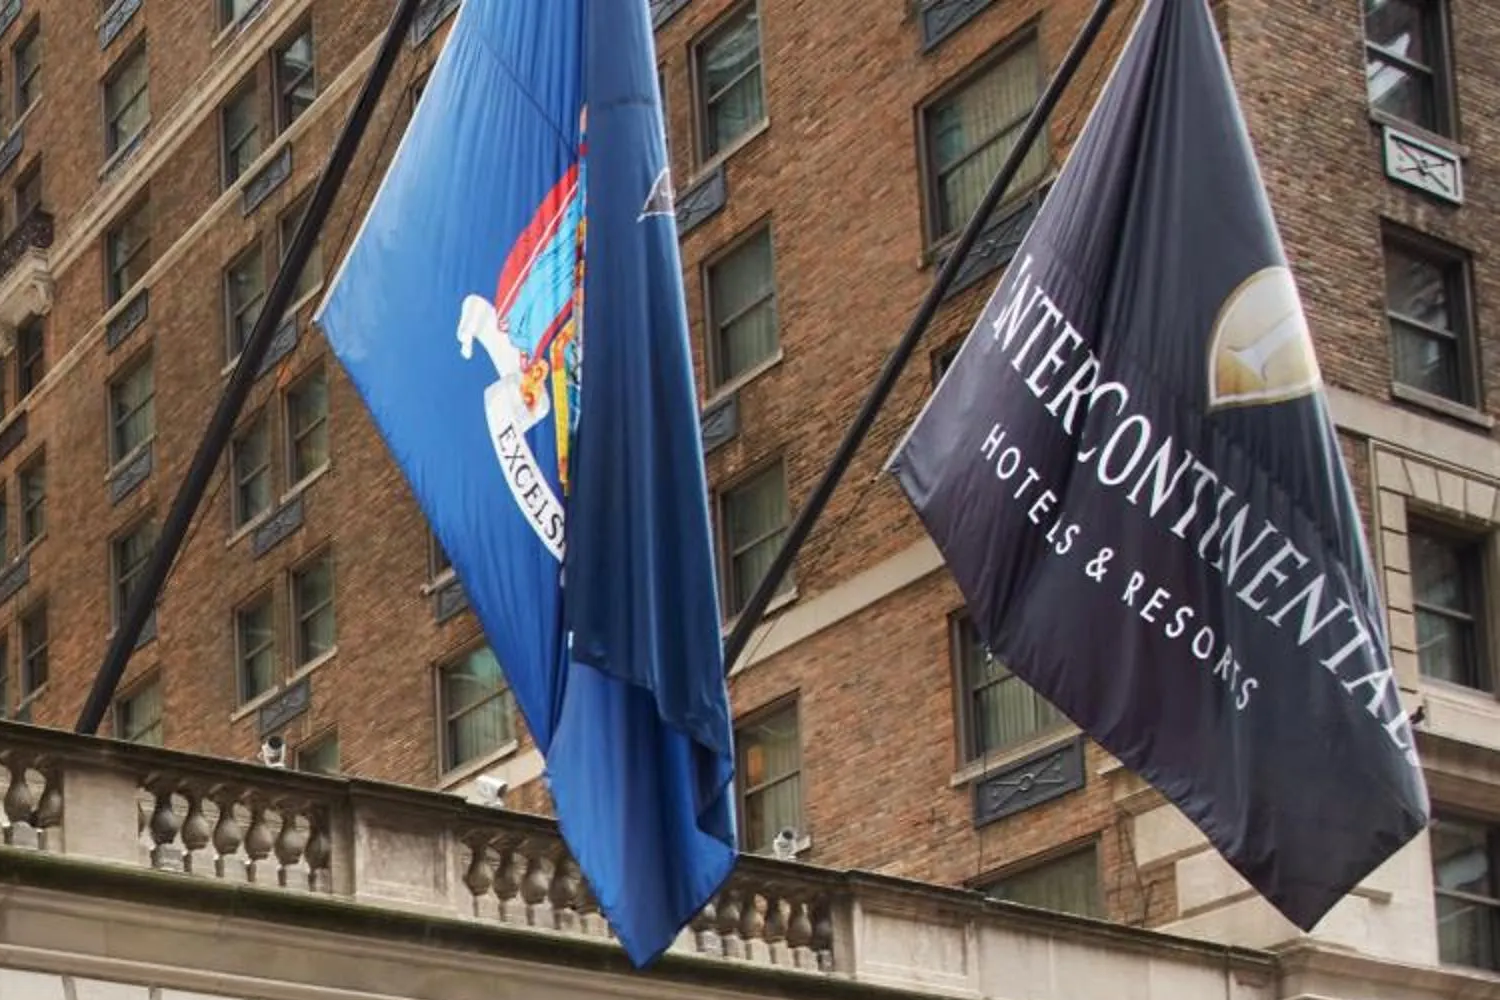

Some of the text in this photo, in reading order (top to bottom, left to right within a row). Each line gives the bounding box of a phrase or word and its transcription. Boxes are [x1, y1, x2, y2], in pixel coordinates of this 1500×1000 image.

[980, 423, 1270, 711] HOTELS & RESORTS
[993, 253, 1420, 767] INTERCONTINENTAL
